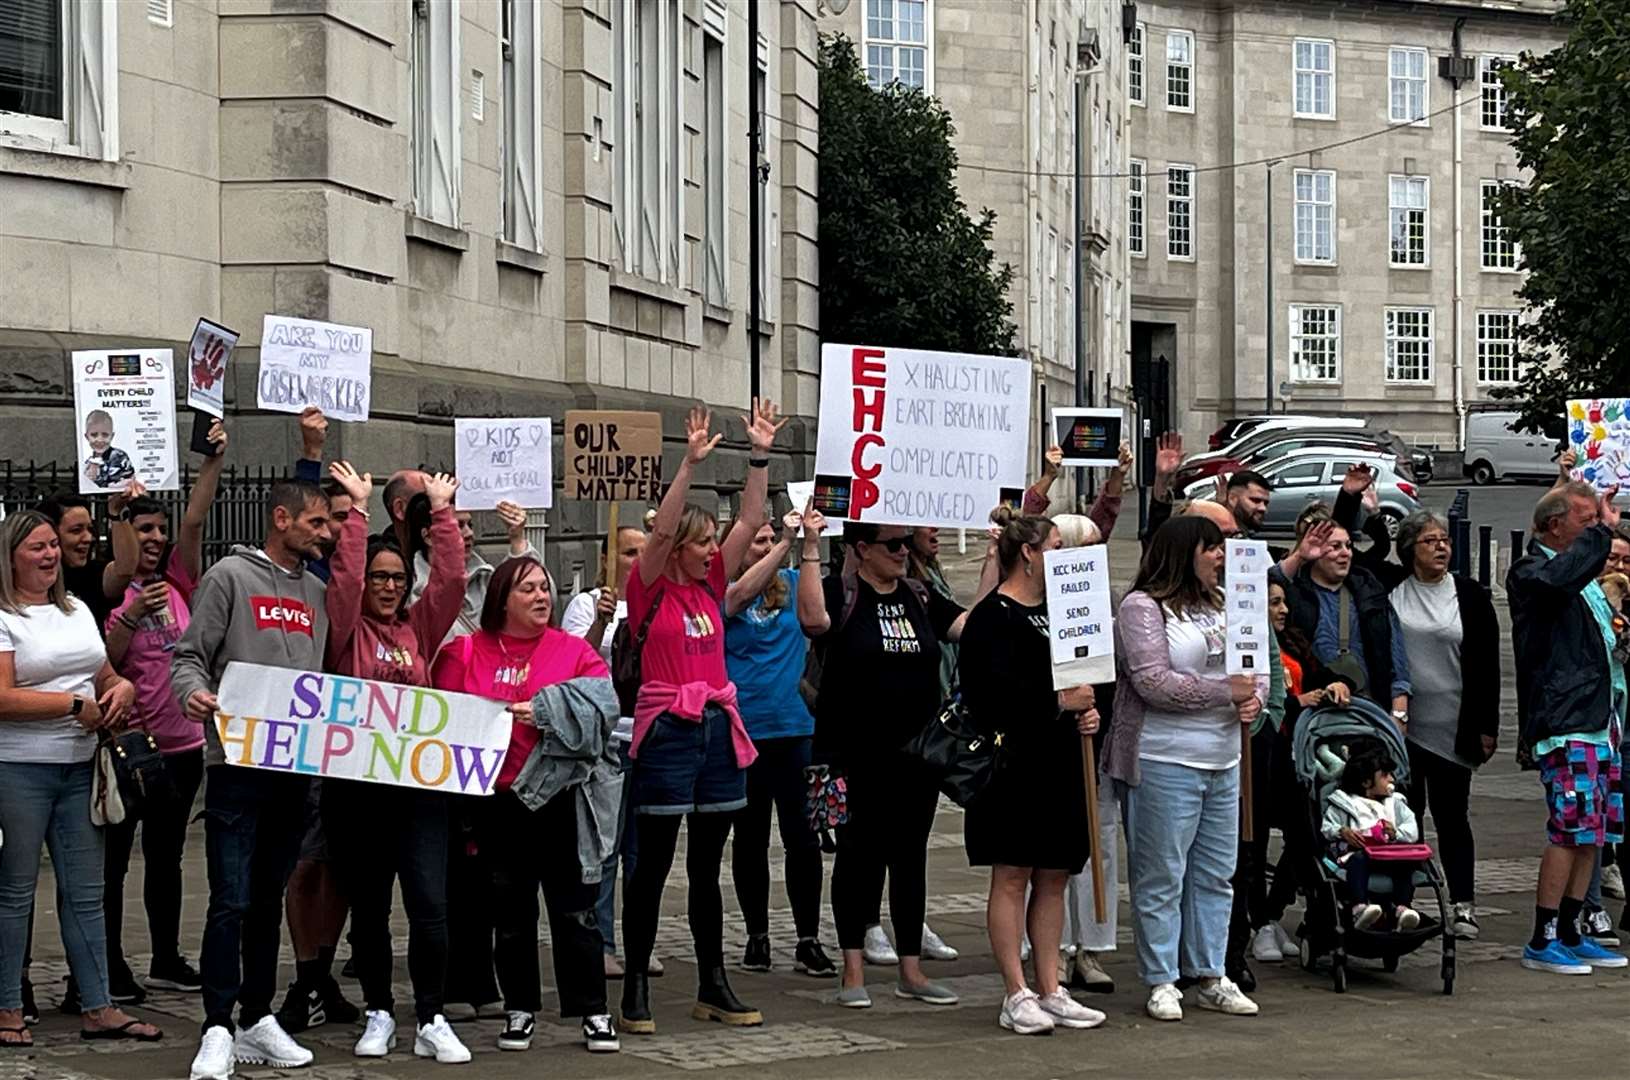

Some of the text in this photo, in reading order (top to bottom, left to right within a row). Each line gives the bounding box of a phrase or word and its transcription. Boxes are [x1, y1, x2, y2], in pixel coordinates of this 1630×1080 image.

[269, 324, 363, 353] ARE YOU
[299, 352, 329, 369] MY
[97, 387, 155, 398] EVERY CHILD
[486, 427, 521, 448] KIDS
[574, 423, 621, 452] OUR
[491, 450, 515, 464] NOT
[573, 455, 663, 481] CHILDREN
[1071, 561, 1096, 573] HAVE
[1061, 581, 1091, 594] FAILED
[877, 603, 905, 617] SEND
[1066, 606, 1090, 620] SEND
[1058, 623, 1102, 640] CHILDREN
[883, 638, 921, 653] REFORM
[214, 713, 506, 794] HELP NOW
